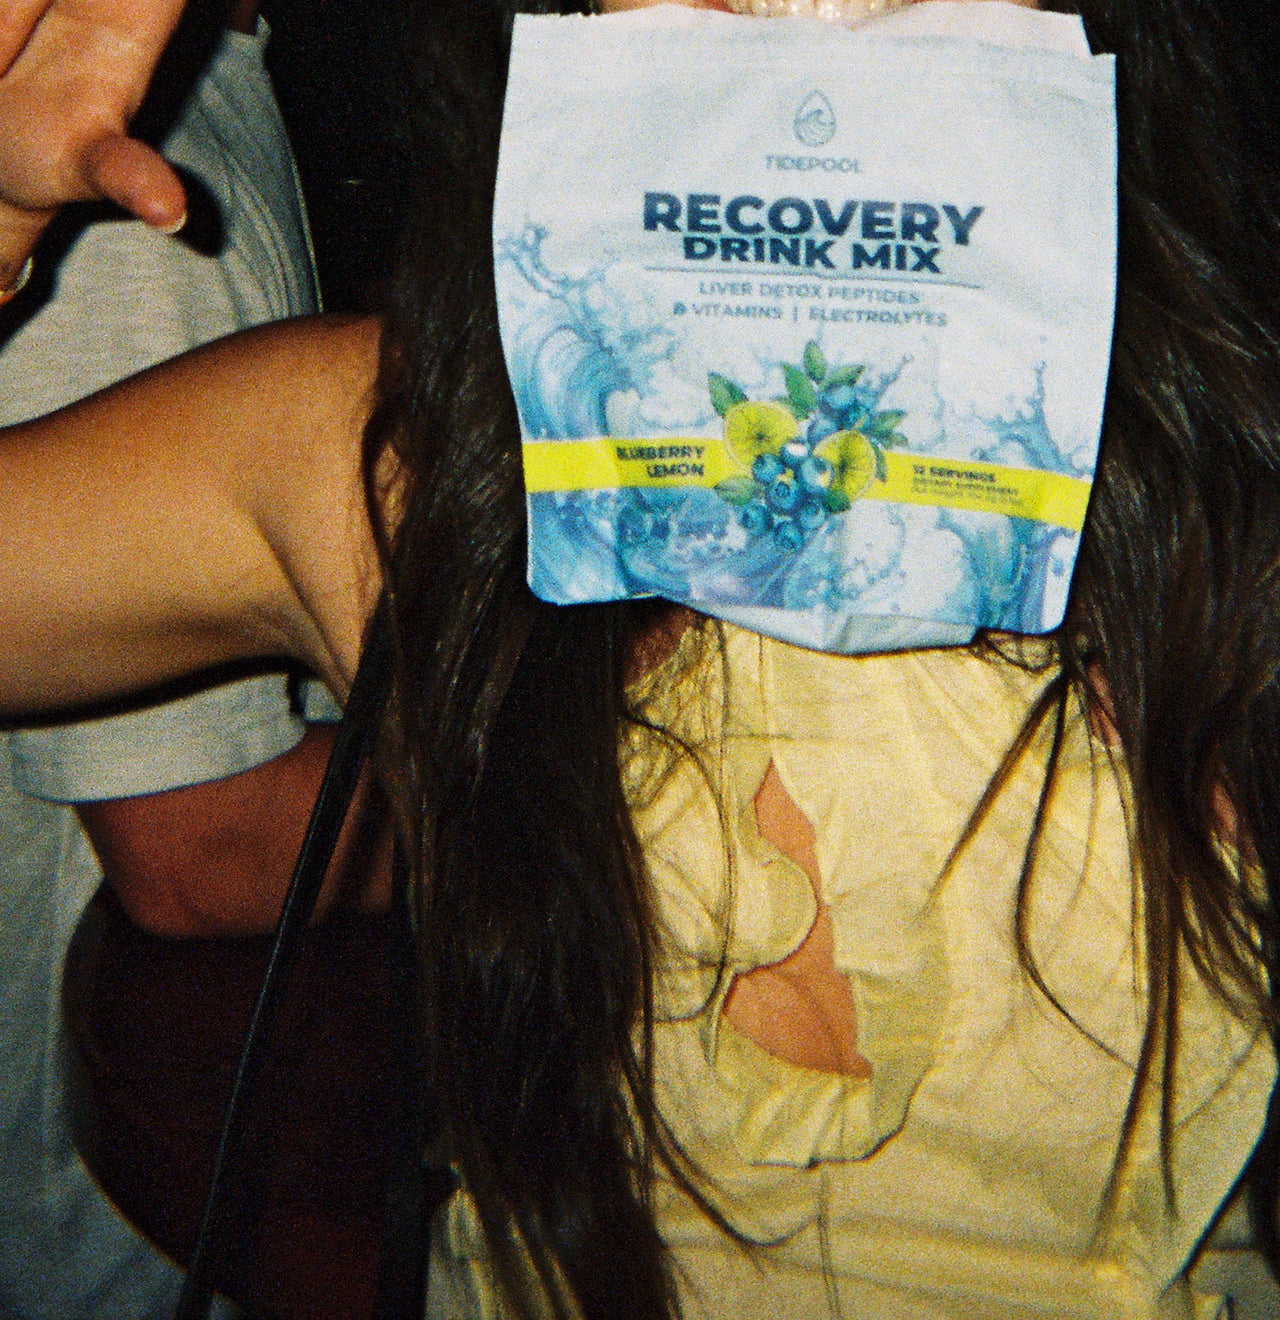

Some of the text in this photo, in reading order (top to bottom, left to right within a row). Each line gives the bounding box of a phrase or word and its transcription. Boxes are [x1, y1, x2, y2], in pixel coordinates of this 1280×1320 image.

[765, 153, 861, 173] TIDEPOOL
[643, 191, 985, 247] RECOVERY
[683, 236, 942, 274] DRINK MIX
[698, 280, 921, 304] LIVER DETOX PEPTIDES
[691, 302, 782, 320] VITAMINS
[809, 304, 948, 328] ELECTROLYTES
[646, 463, 705, 478] LEMON
